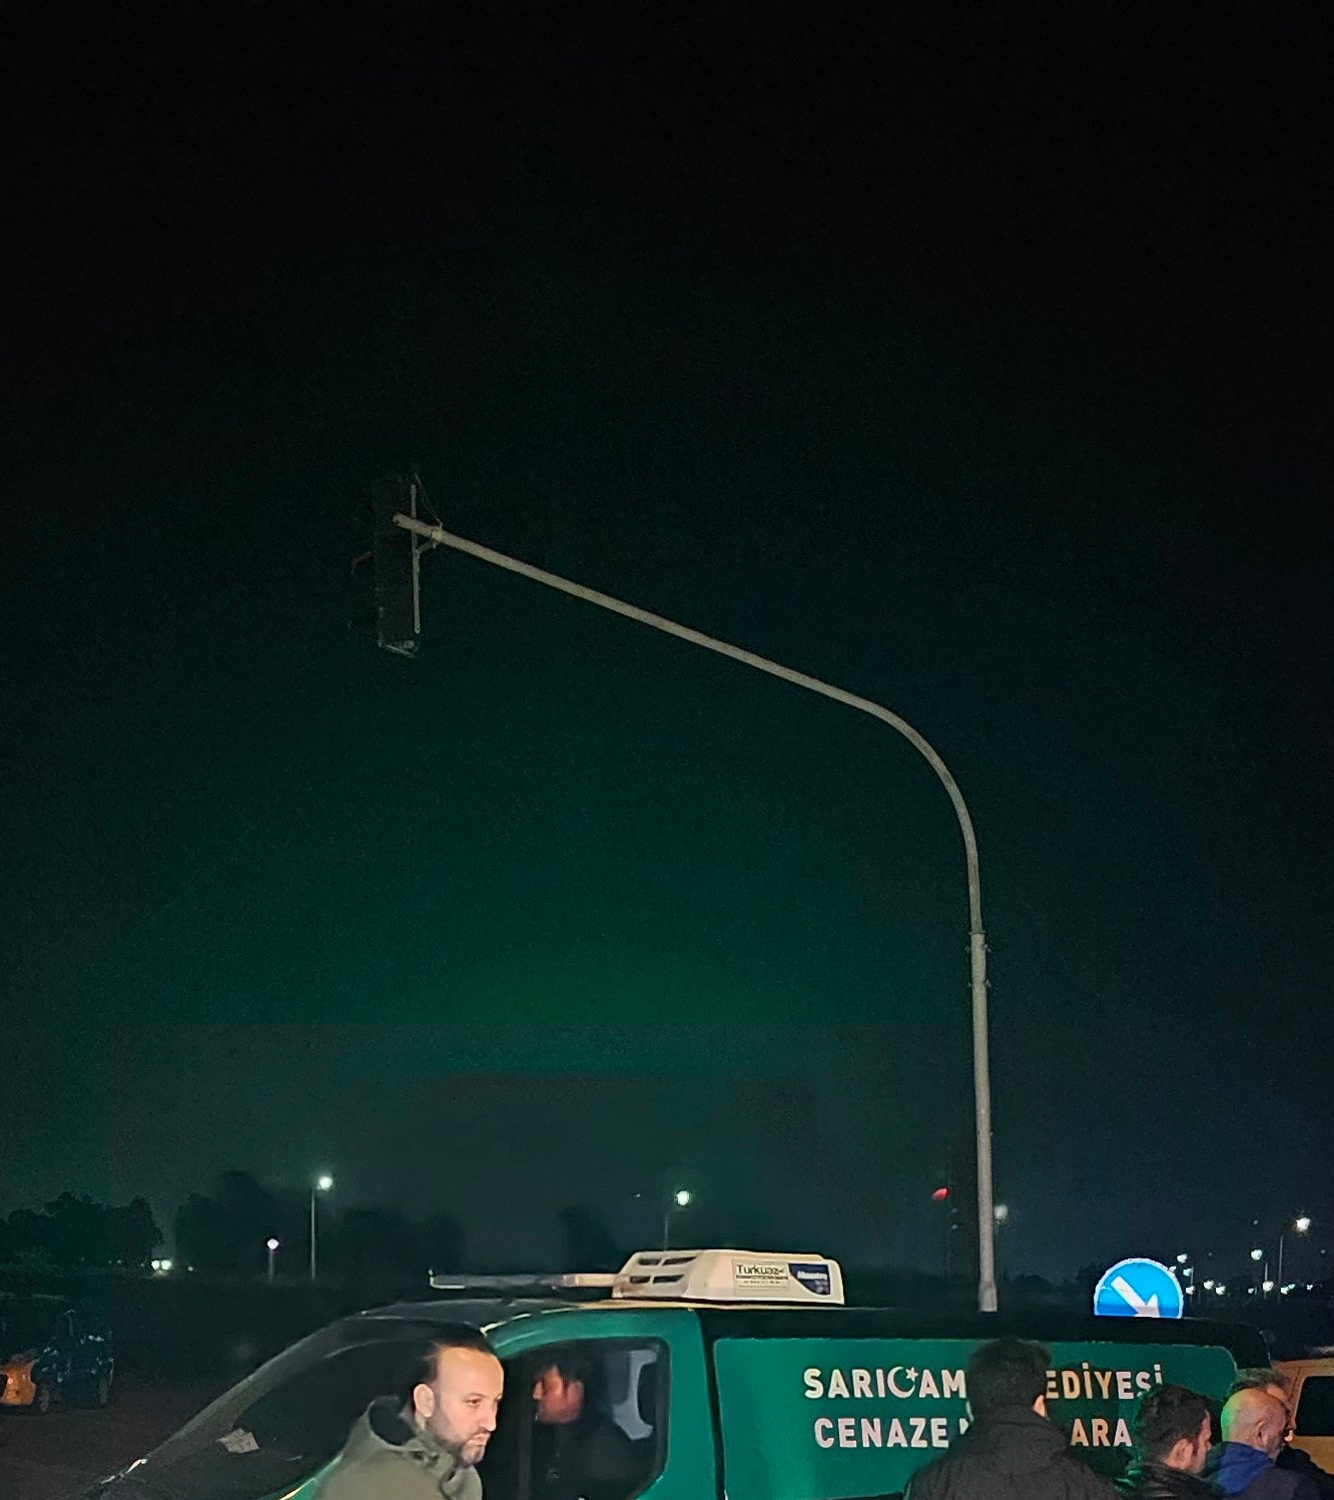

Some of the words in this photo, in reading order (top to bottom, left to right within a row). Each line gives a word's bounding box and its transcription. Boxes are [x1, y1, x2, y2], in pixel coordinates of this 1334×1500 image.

[1045, 1361, 1163, 1400] EDİYESİ
[813, 1417, 950, 1449] CENAZE
[1069, 1417, 1133, 1448] ARA
